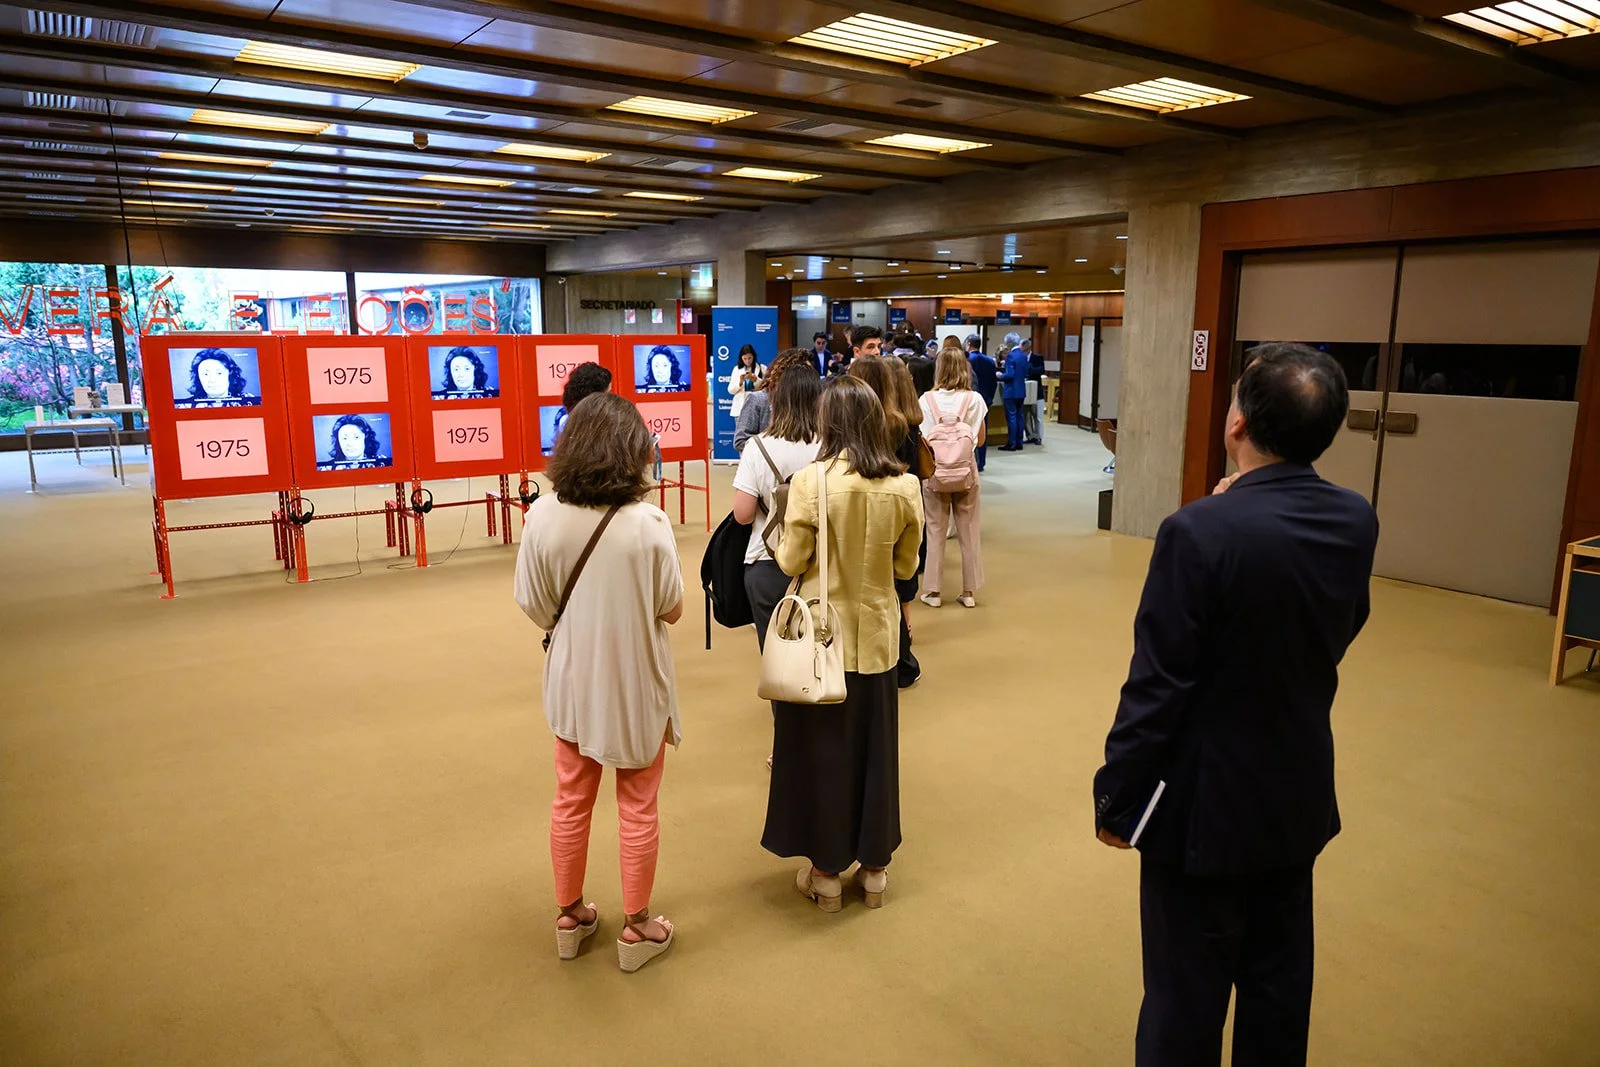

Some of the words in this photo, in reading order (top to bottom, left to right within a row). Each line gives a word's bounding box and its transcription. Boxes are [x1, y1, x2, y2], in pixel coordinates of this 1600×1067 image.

[580, 299, 656, 310] SECRETARIADO
[324, 367, 372, 385] 1975
[549, 363, 582, 379] 197
[647, 418, 681, 433] 1975
[447, 427, 489, 444] 1975
[196, 439, 250, 459] 1975
